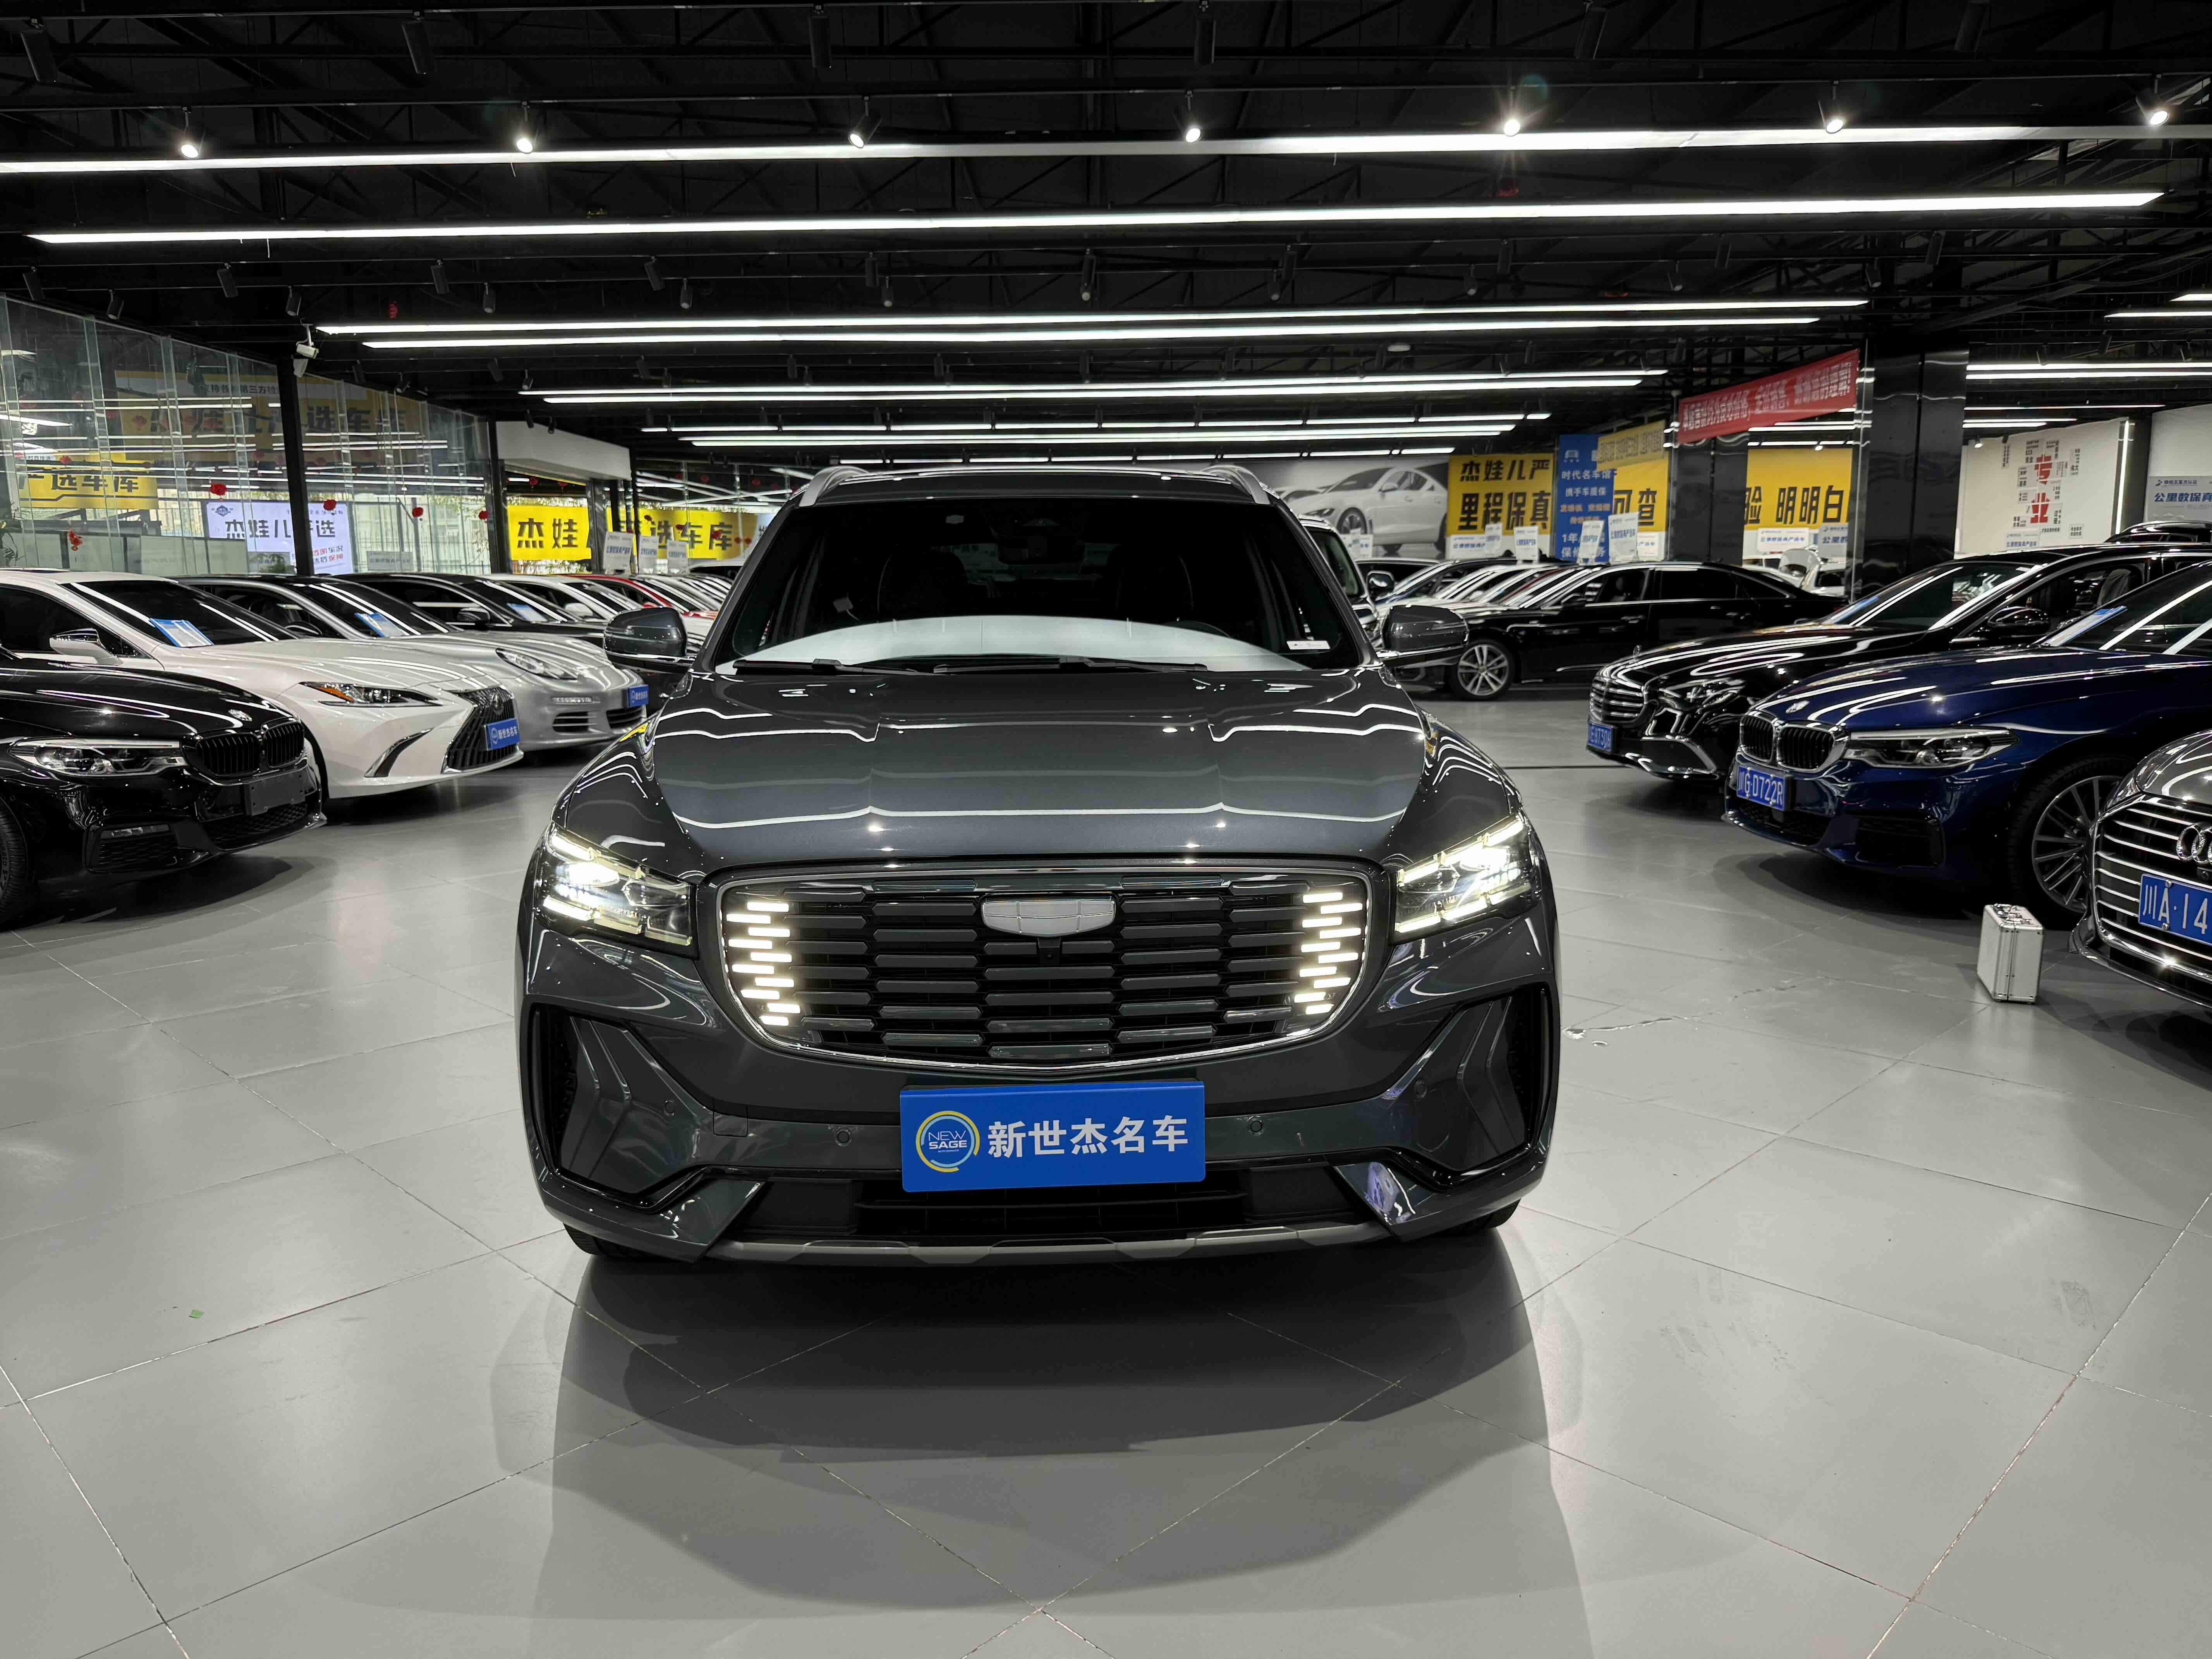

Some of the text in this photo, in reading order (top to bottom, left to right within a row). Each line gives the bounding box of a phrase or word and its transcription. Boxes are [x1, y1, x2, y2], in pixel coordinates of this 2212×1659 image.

[1460, 459, 1550, 481] 杰娃儿严
[1458, 491, 1551, 531] 里程保真
[1776, 485, 1850, 524] 明明白
[225, 519, 335, 538] 杰娃儿选
[517, 518, 579, 549] 杰娃
[928, 1130, 967, 1142] NEW
[929, 1140, 967, 1149] SAGE
[988, 1115, 1188, 1158] 新世杰名车
